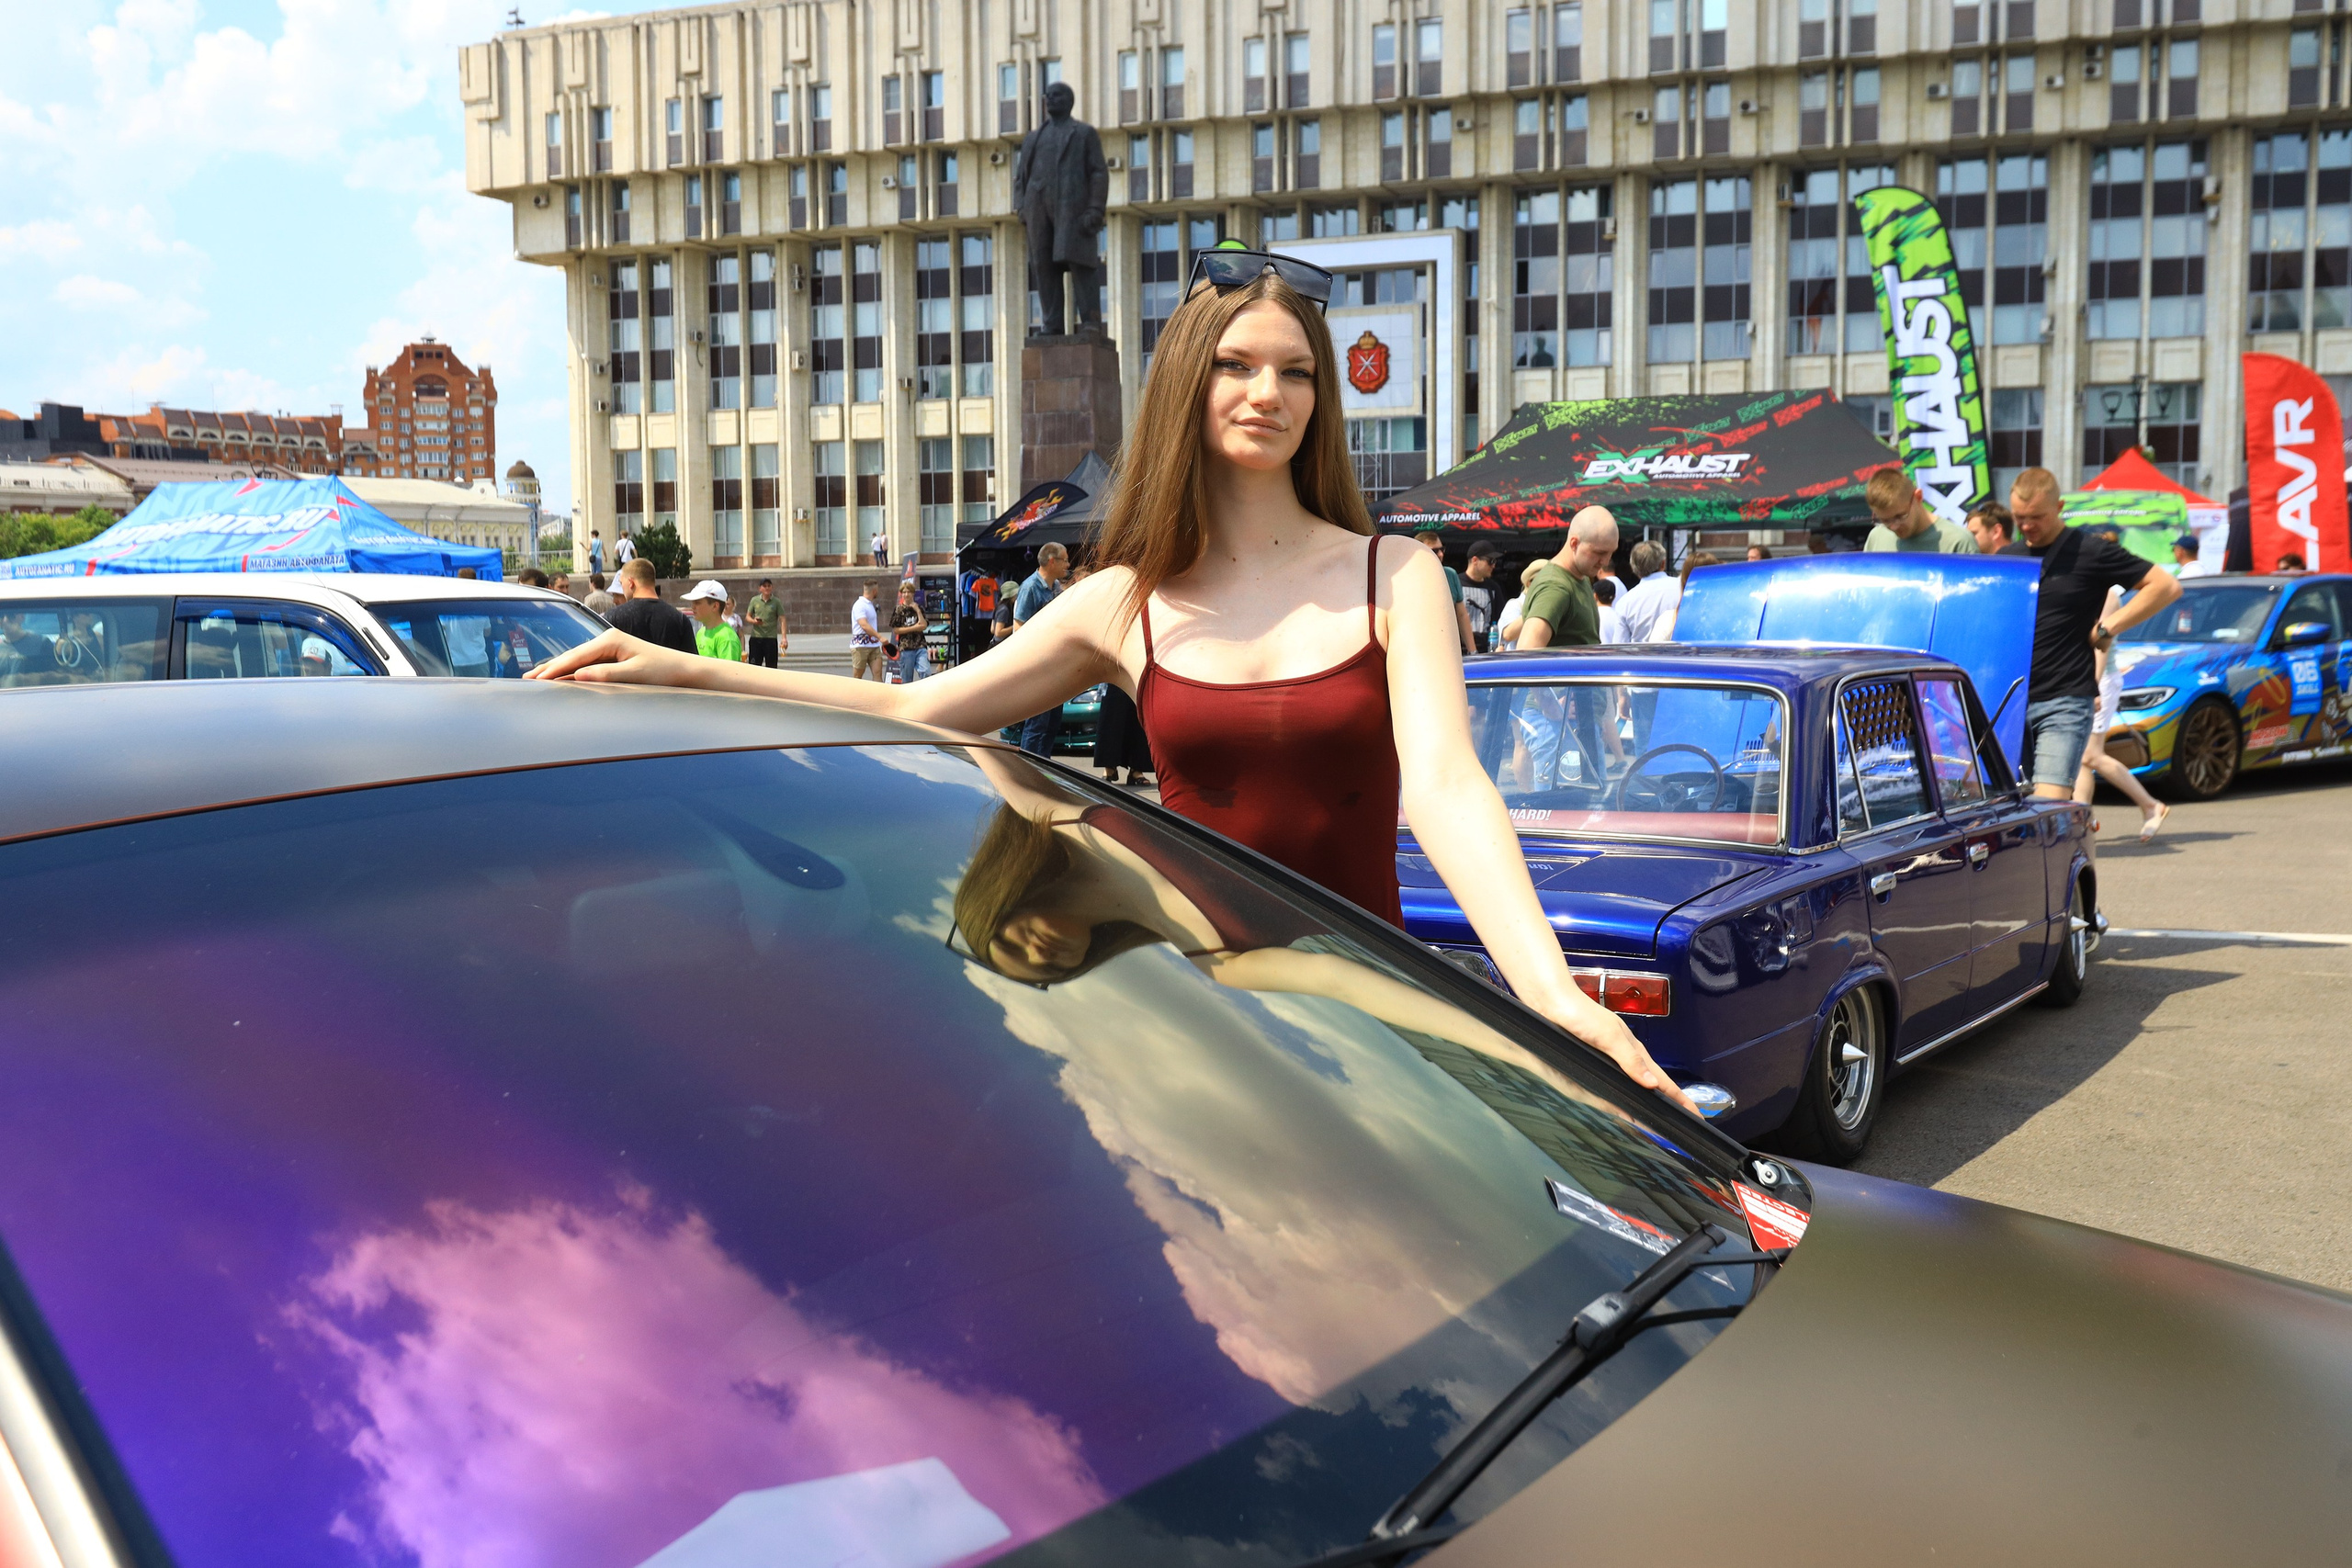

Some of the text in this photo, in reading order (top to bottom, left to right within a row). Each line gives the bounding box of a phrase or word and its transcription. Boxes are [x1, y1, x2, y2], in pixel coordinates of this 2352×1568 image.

[1883, 265, 1974, 528] XHAUST
[1580, 449, 1751, 482] EXHAUST
[1379, 512, 1481, 524] AUTOMOTIVE APPAREL
[250, 555, 345, 570] МАГАЗИН АВТОФАНАТА
[15, 563, 75, 577] AUTOFANATIC.RU
[1510, 808, 1553, 821] HARD!
